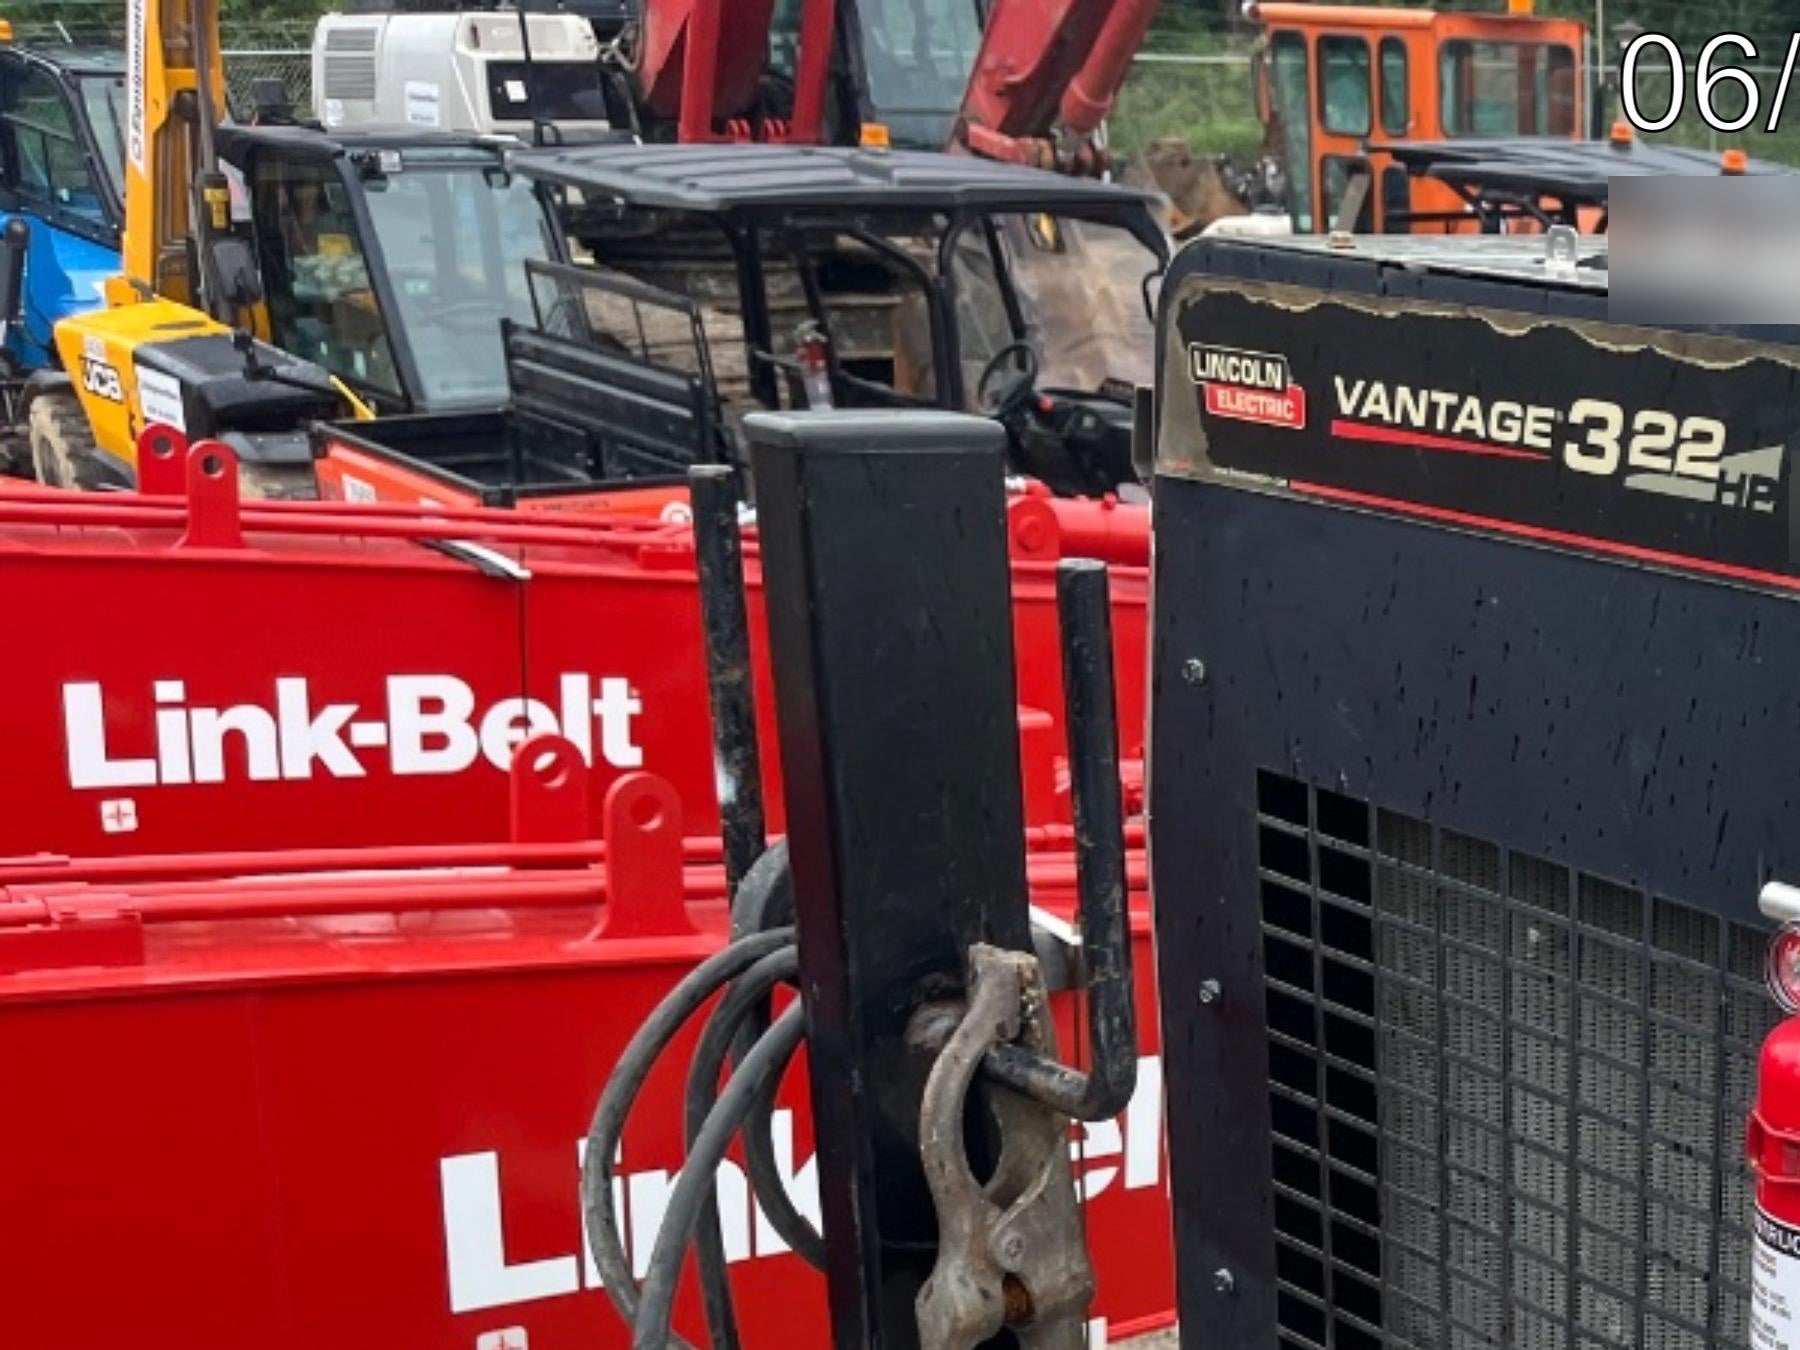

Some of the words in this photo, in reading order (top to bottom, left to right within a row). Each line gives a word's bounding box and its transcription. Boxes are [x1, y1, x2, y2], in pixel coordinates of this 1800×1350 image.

[80, 354, 123, 404] JCB
[1193, 350, 1283, 391] LINCOLN
[1216, 388, 1295, 421] ELECTRIC
[1333, 375, 1554, 449] VANTAGE
[1562, 397, 1727, 479] 322
[62, 671, 643, 790] Link-Belt
